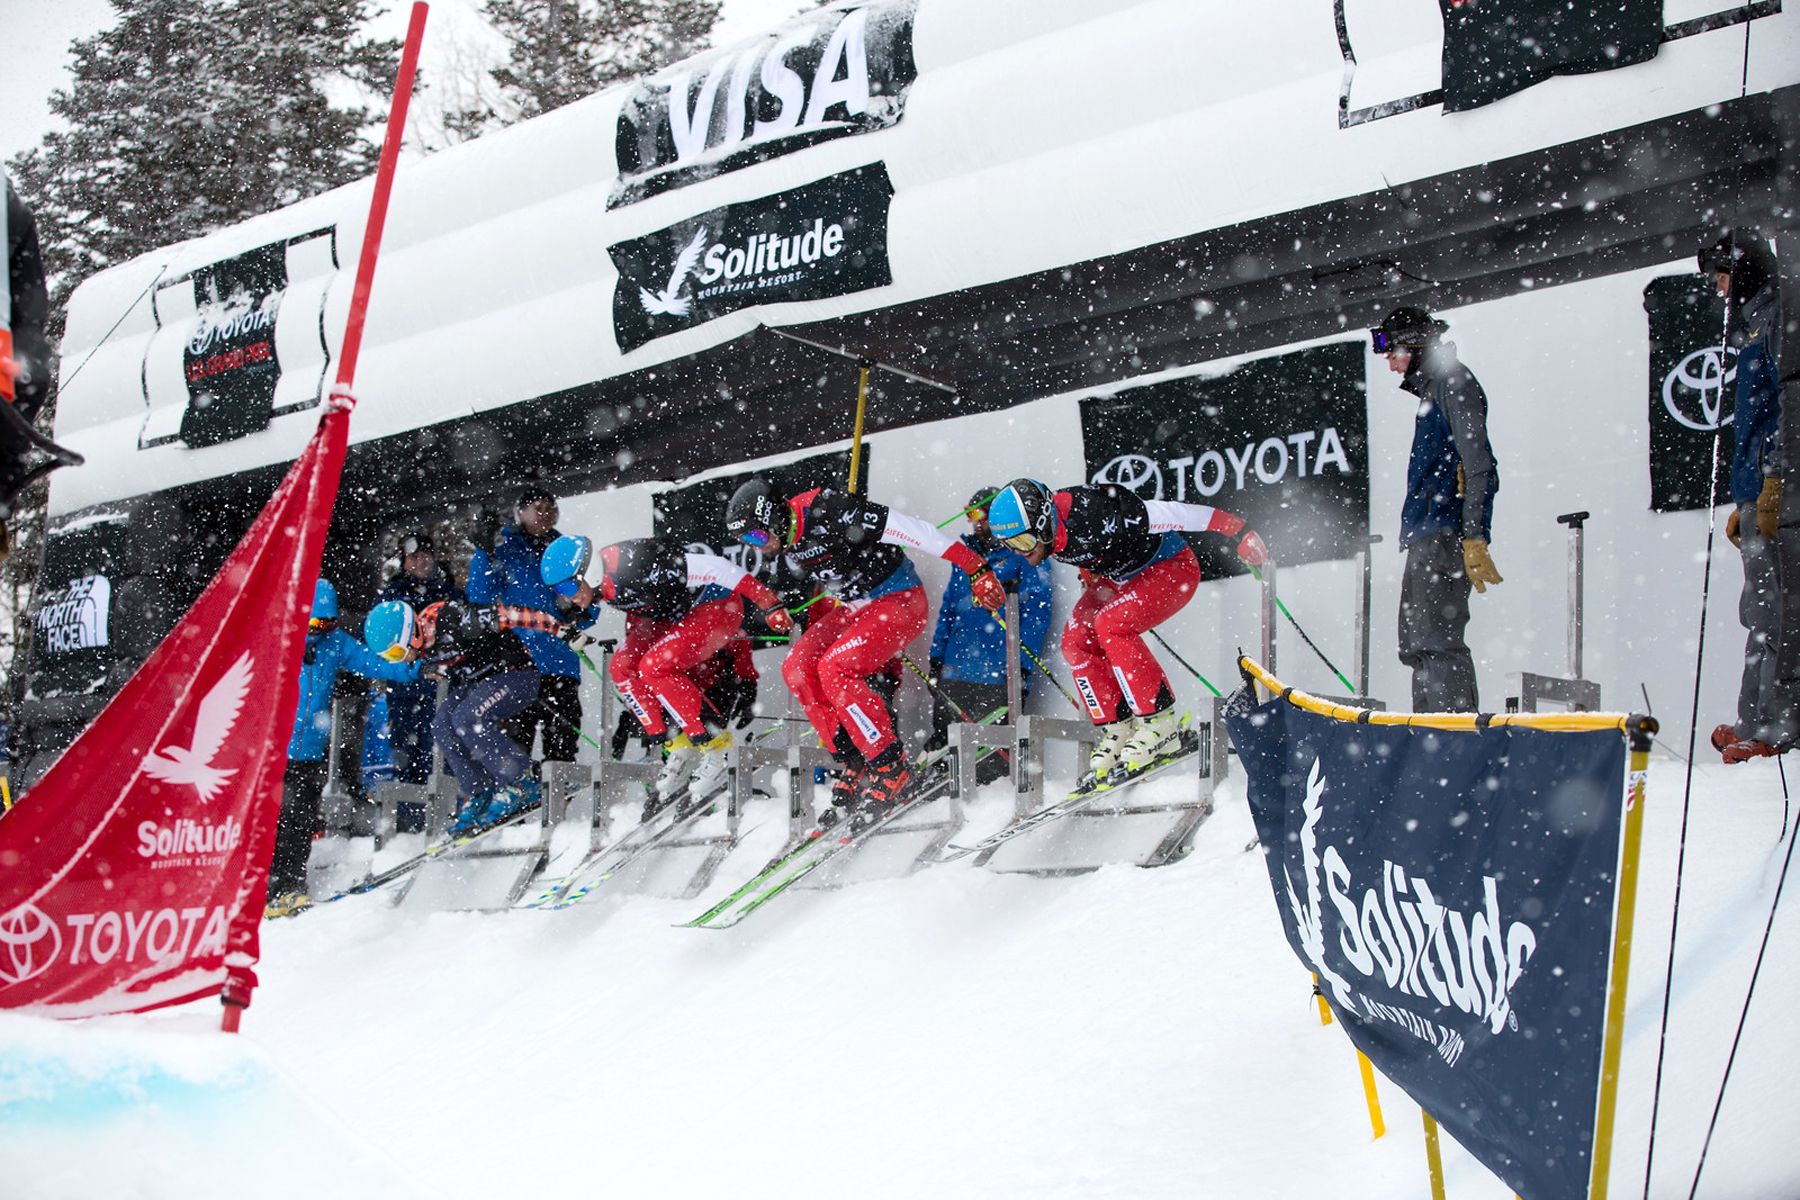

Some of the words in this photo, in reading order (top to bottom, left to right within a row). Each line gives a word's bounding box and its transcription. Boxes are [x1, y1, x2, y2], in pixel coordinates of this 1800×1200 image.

[668, 7, 870, 163] VISA
[699, 217, 845, 285] Solitude
[1167, 426, 1351, 502] TOYOTA
[860, 511, 879, 531] 13
[38, 599, 82, 630] NORTH
[47, 623, 82, 654] FACE
[474, 684, 508, 718] CANADA
[1077, 678, 1098, 708] BKW
[1147, 730, 1179, 755] HEAD
[137, 814, 242, 858] Solitude
[66, 904, 229, 966] TOYOTA
[1322, 845, 1537, 1036] Solitude
